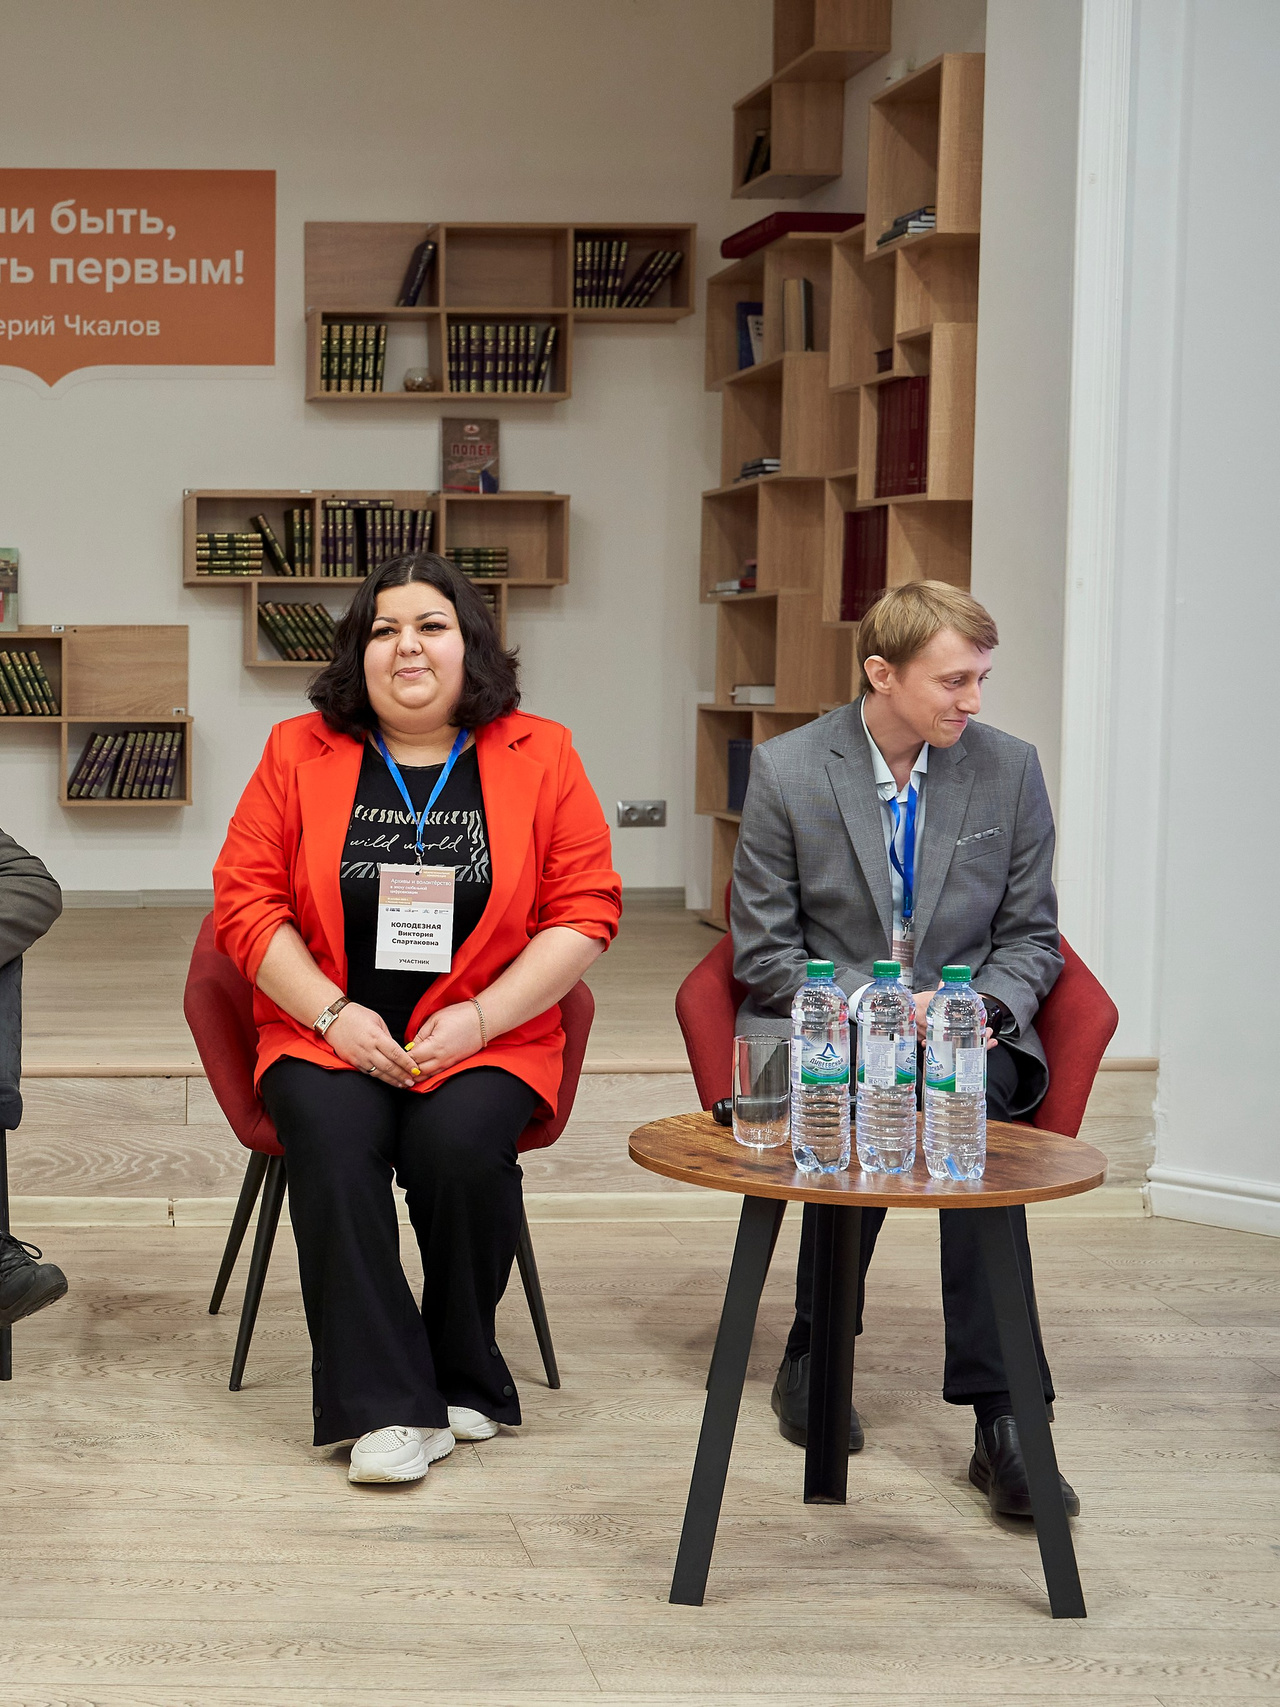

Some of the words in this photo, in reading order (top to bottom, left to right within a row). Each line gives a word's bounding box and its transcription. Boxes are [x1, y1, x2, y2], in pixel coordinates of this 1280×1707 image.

[50, 199, 177, 241] быть,
[49, 250, 245, 293] первым!
[64, 314, 160, 336] Чкалов
[350, 834, 400, 852] wild
[391, 922, 441, 930] КОЛОДЕЗНАЯ
[398, 930, 434, 938] Виктория
[391, 938, 439, 946] Спартаковна
